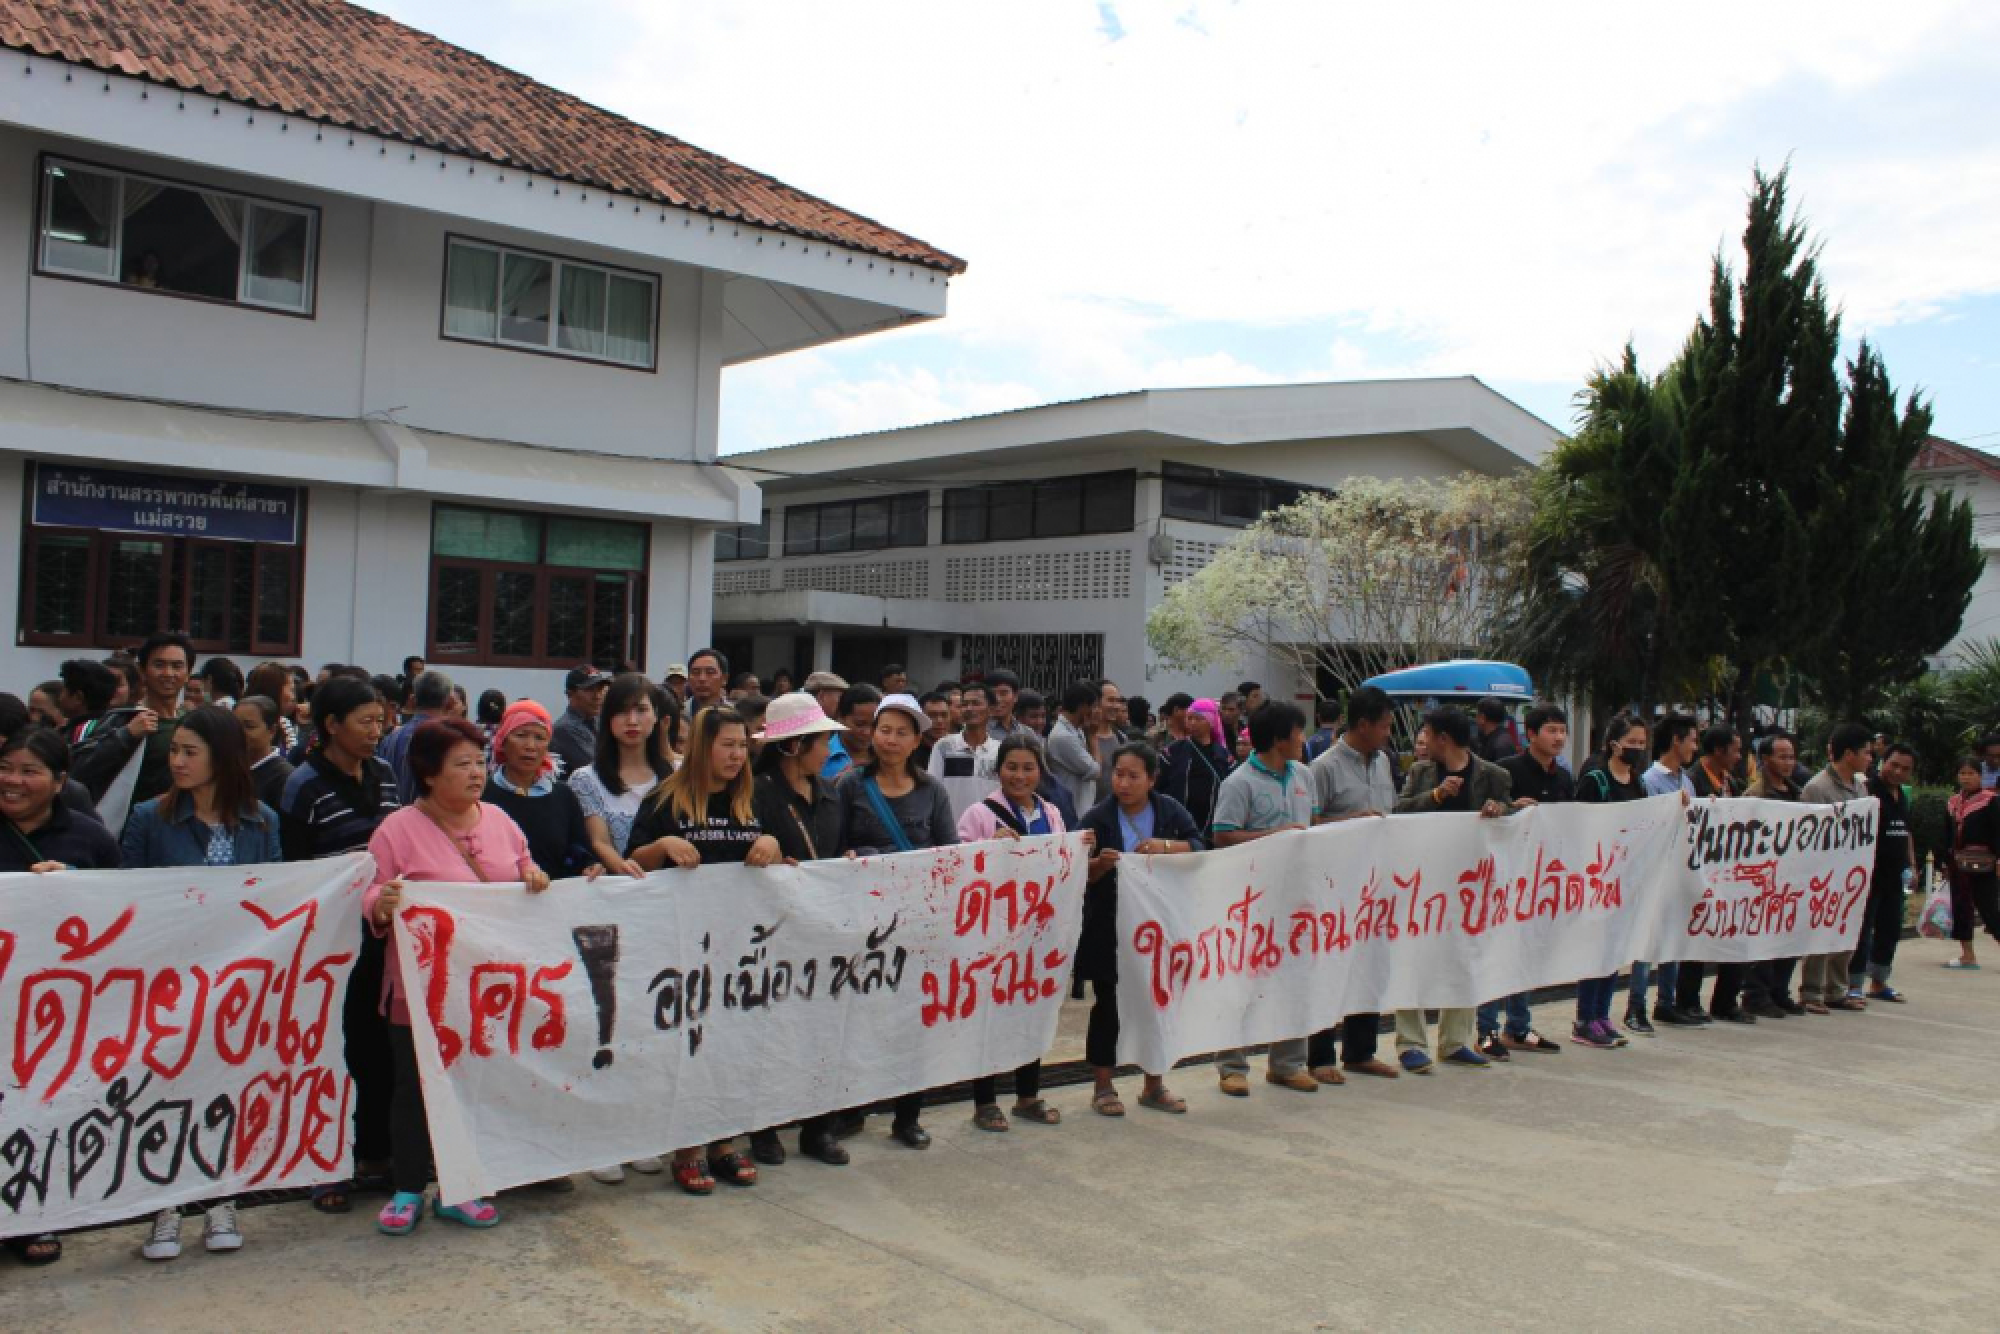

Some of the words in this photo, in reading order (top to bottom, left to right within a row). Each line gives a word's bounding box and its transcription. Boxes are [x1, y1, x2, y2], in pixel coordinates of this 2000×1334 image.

[46, 471, 287, 515] สำนักงานสรรพากรพื้นที่สาขา
[132, 507, 208, 531] แม่สรวย
[954, 850, 1055, 937] ด่าน
[0, 898, 354, 1103] ด้วยอะไร
[921, 947, 1067, 1028] มรณะ
